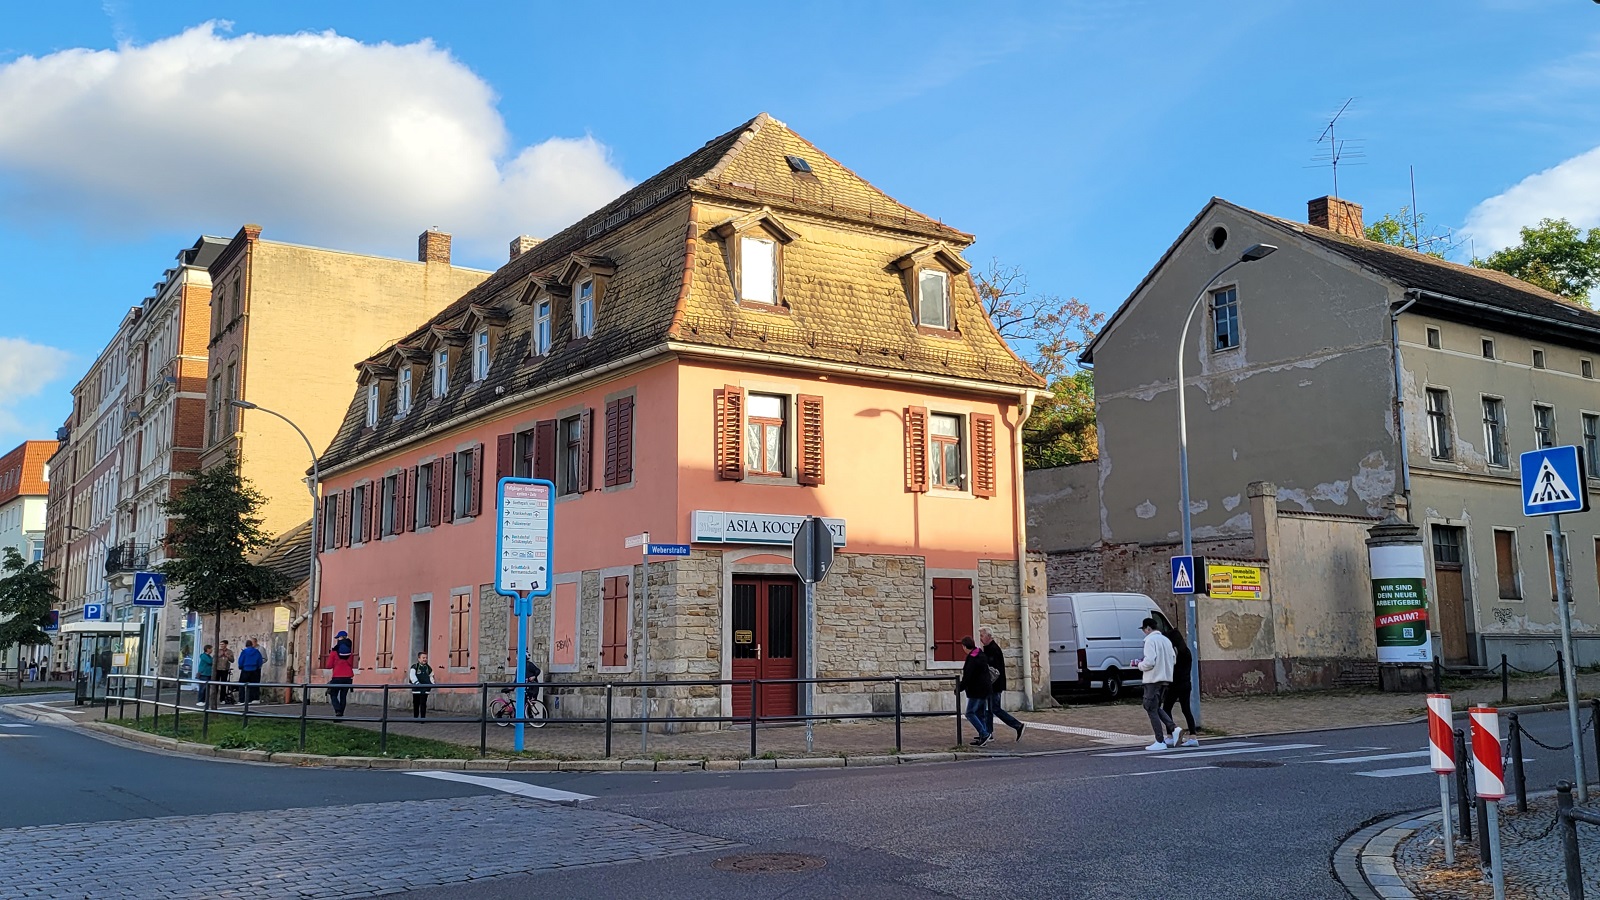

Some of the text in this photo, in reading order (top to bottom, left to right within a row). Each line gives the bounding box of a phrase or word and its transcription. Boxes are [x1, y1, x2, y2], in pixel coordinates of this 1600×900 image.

[726, 519, 845, 536] ASIA KOCHST
[651, 546, 687, 554] Weberstraße
[88, 606, 98, 618] P
[1380, 612, 1419, 625] WARUM?
